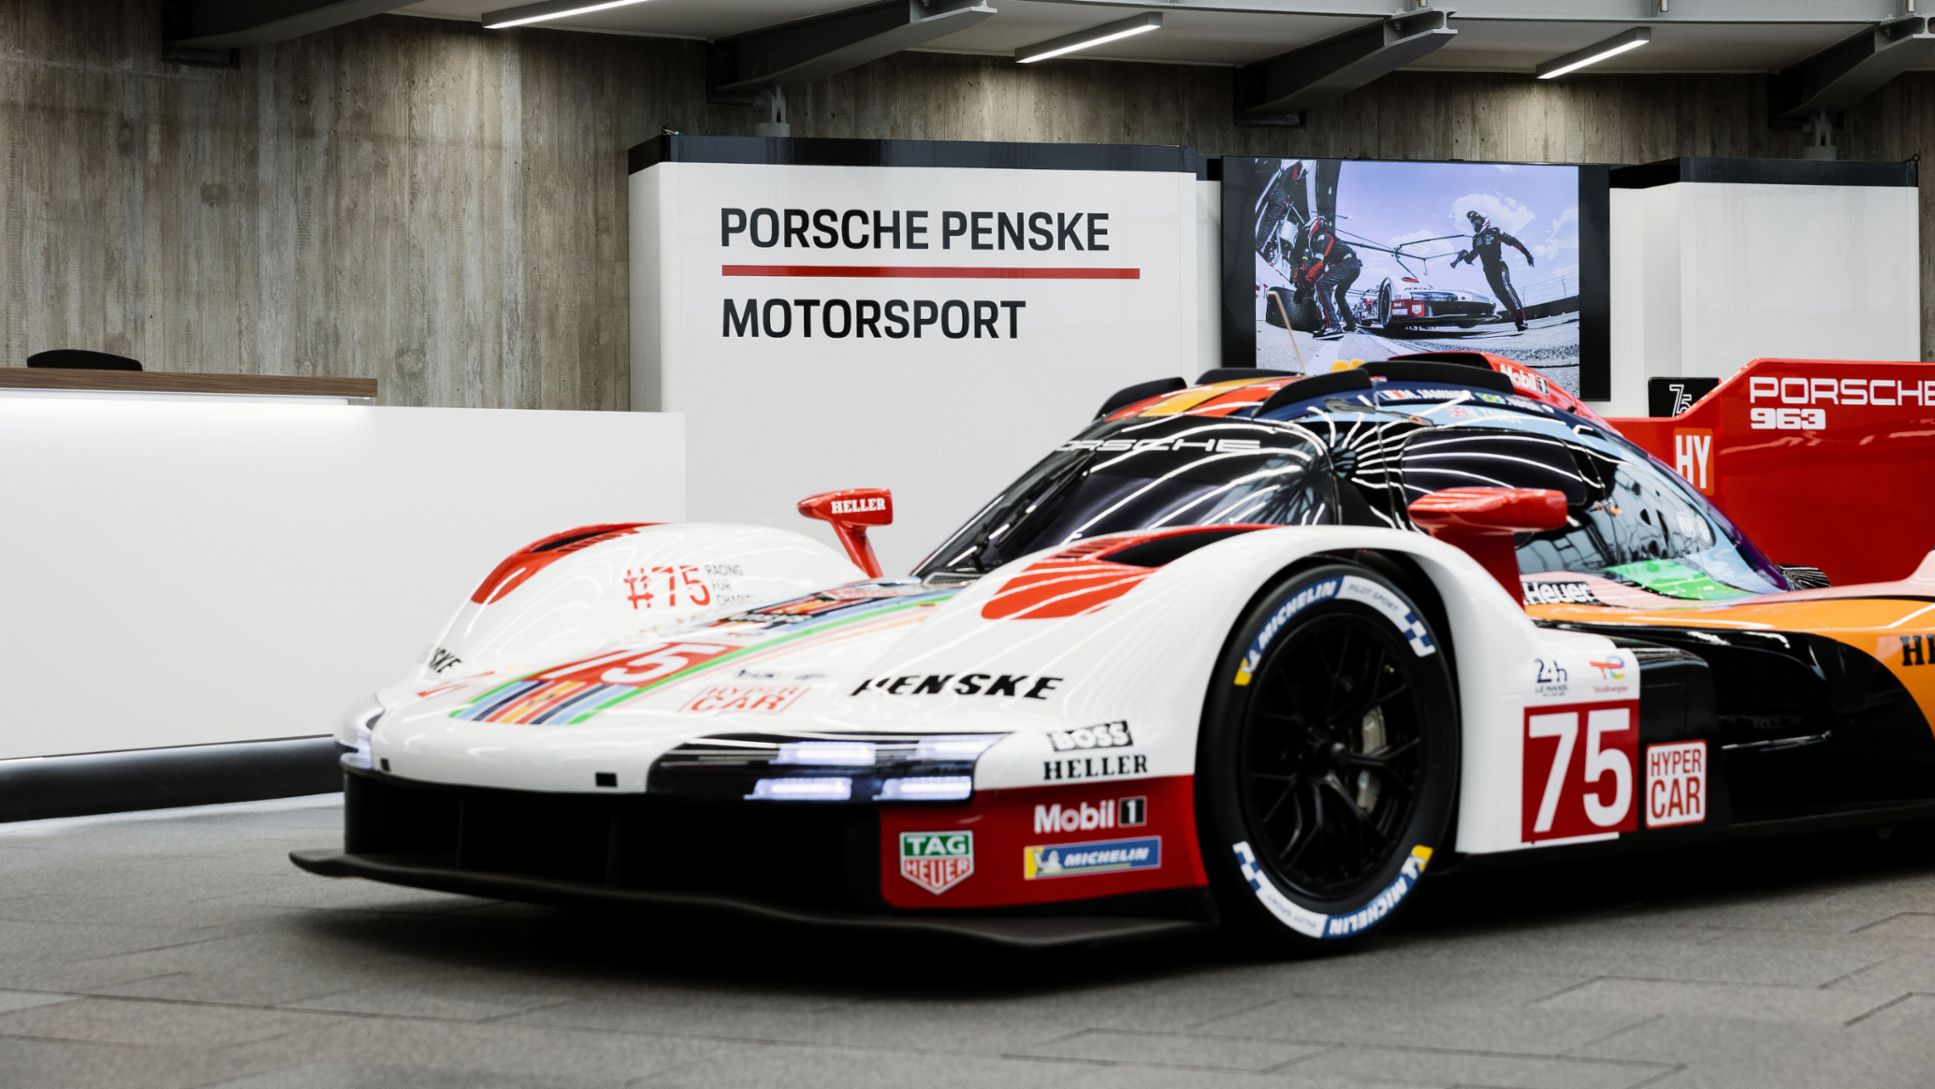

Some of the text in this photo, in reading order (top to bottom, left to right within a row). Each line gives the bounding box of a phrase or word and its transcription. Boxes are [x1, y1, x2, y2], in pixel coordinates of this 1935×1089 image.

[721, 207, 1110, 252] PORSCHE PENSKE
[722, 298, 1026, 340] MOTORSPORT
[1750, 408, 1826, 430] 963
[1675, 435, 1711, 489] HY
[831, 498, 886, 514] HELLER
[624, 565, 710, 609] #75
[1258, 580, 1338, 650] MICHELIN
[850, 674, 1063, 700] PENSKE
[1050, 722, 1129, 750] BOSS
[1044, 755, 1148, 781] HELLER
[1529, 708, 1633, 832] 75
[1650, 748, 1702, 777] HYPER
[1650, 776, 1702, 819] CAR
[1034, 799, 1142, 834] Mobil 1
[905, 835, 968, 856] TAG
[1063, 847, 1150, 868] MICHELIN
[904, 858, 970, 890] HEUER
[1328, 876, 1408, 936] MICHELIN
